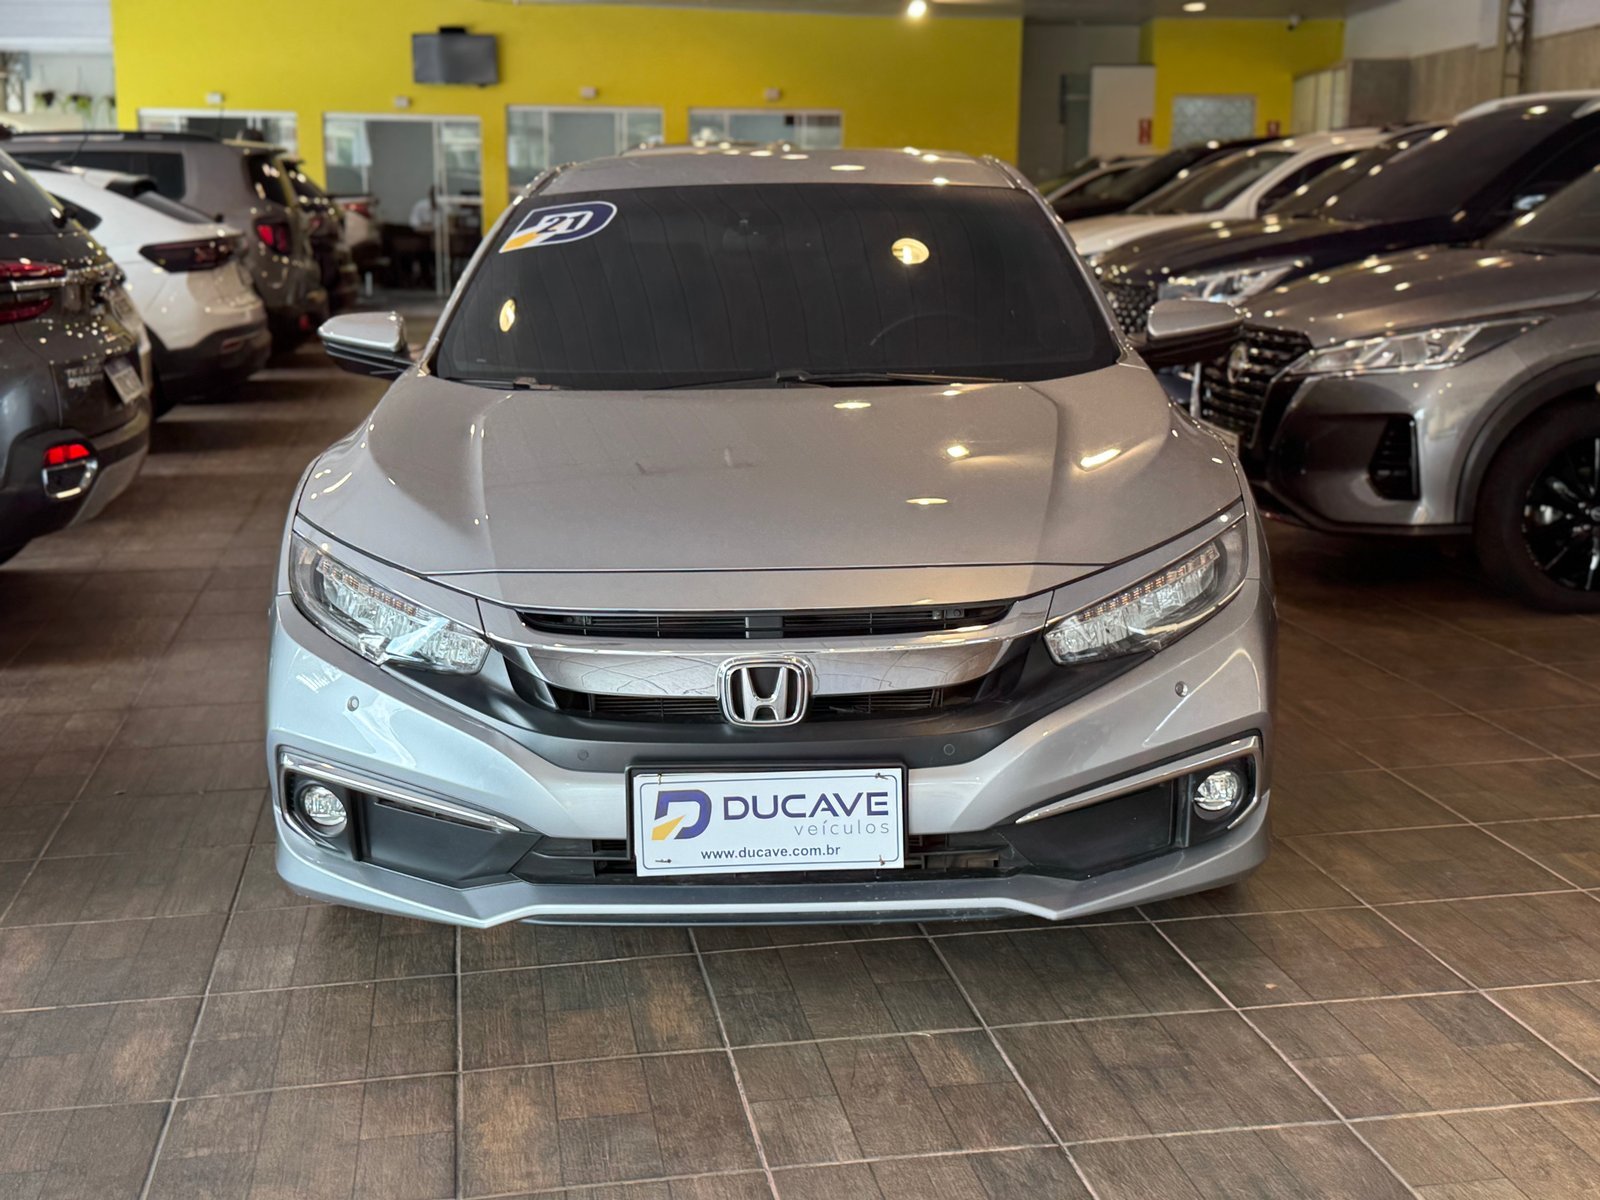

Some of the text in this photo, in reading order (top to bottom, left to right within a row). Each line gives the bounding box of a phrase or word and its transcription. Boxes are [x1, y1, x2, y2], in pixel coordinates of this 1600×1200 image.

[537, 214, 587, 234] 21
[723, 791, 889, 820] DUCAVE
[794, 819, 889, 836] veículos
[700, 844, 841, 860] www.ducave.com.br
